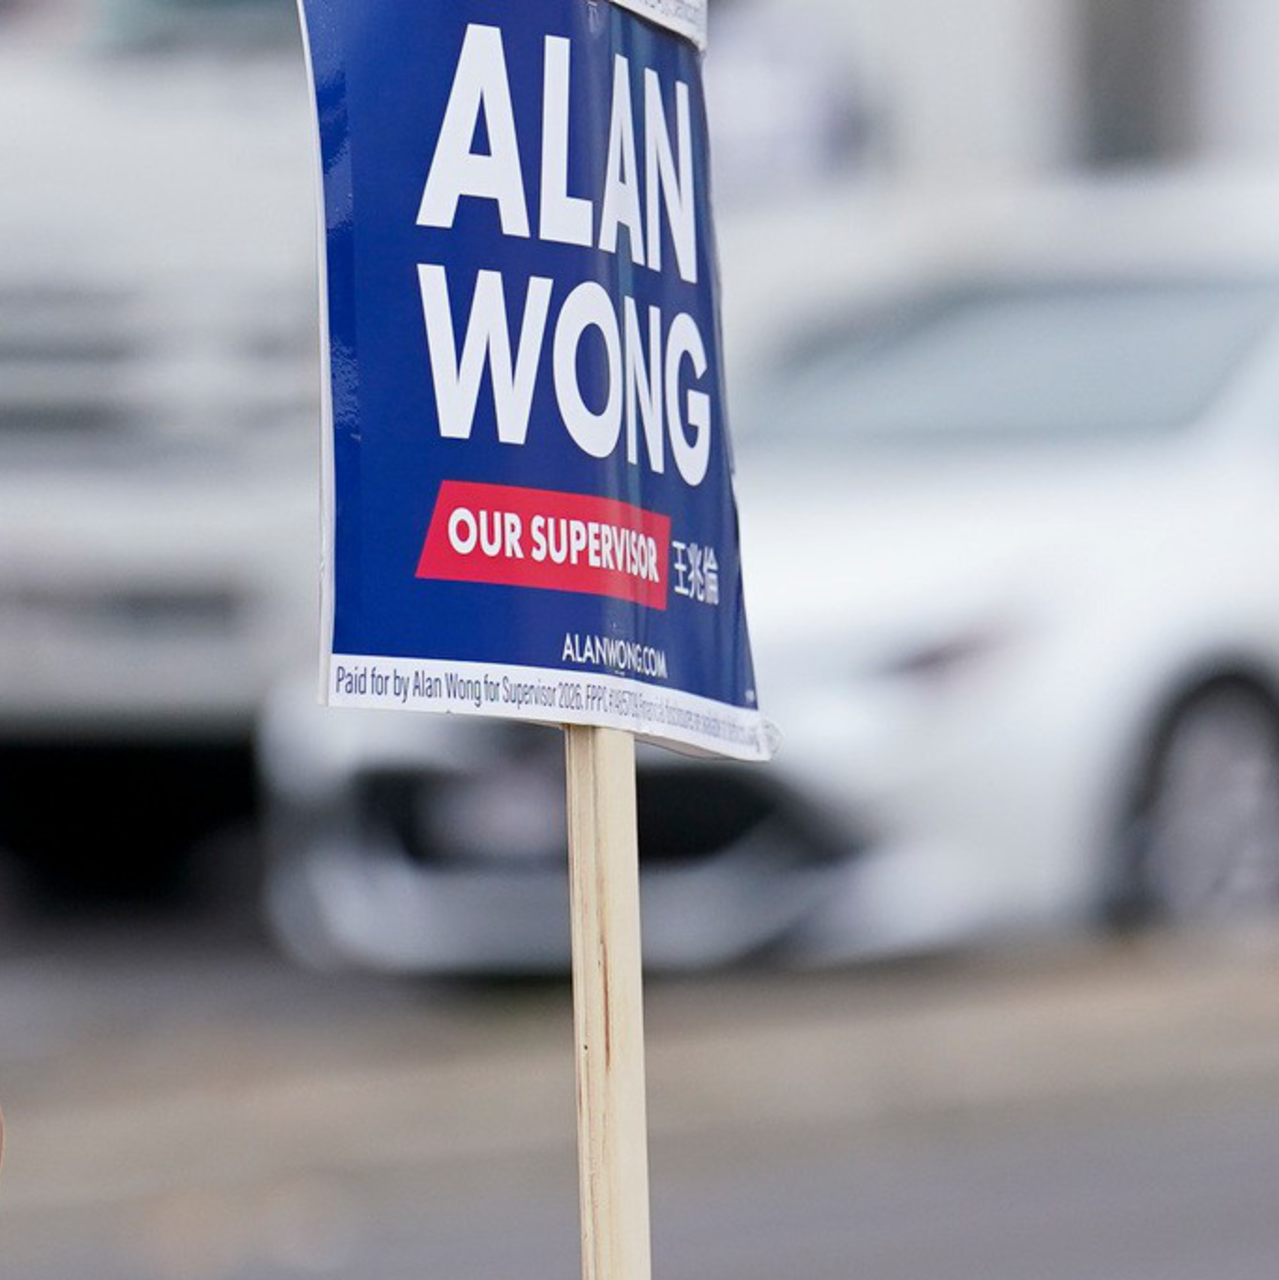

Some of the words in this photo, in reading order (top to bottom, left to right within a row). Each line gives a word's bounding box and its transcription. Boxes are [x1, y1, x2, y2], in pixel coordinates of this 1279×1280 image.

[416, 23, 698, 285] ALAN
[417, 264, 710, 486] WONG
[448, 507, 524, 559] OUR
[531, 514, 660, 583] SUPERVISOR
[336, 665, 367, 694] Paid
[371, 666, 390, 696] for
[393, 668, 410, 703] by
[412, 670, 442, 699] Alan
[445, 672, 482, 708] Wong
[484, 673, 500, 703] for
[502, 675, 557, 710] Supervisor
[562, 633, 668, 679] ALANWONG.COM
